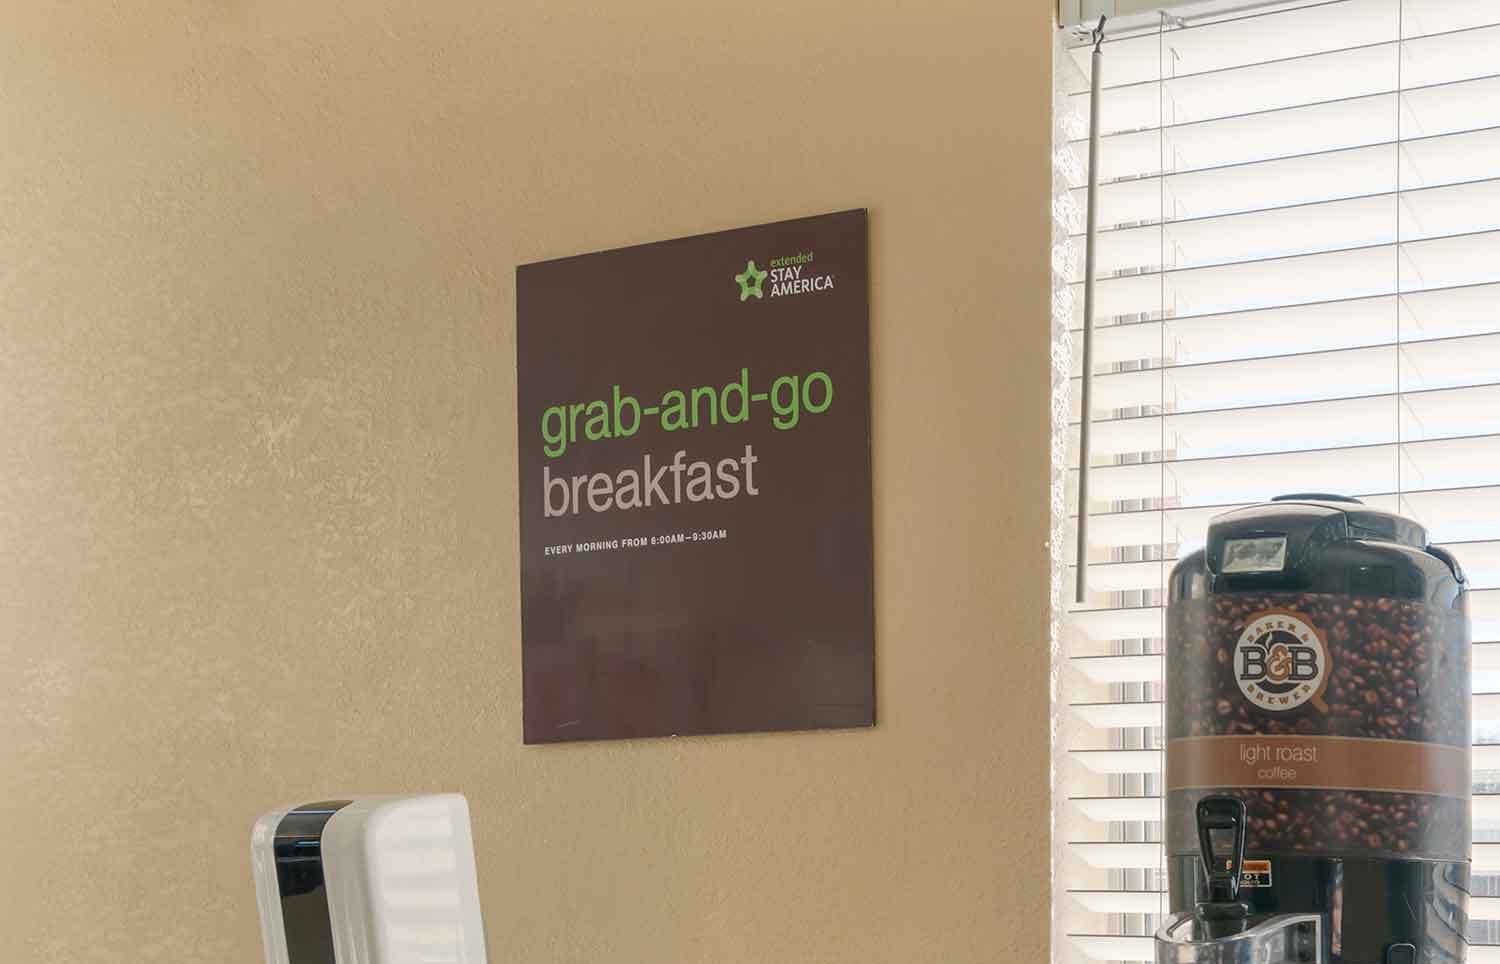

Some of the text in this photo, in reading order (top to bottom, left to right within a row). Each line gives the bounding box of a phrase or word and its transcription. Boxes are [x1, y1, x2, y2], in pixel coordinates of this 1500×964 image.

[770, 251, 813, 268] extended
[770, 265, 802, 283] STAY
[770, 275, 834, 297] AMERICA
[541, 367, 833, 458] grab-and-go
[543, 445, 759, 517] breakfast
[544, 544, 573, 555] EVERY
[576, 540, 618, 552] MORNING
[622, 537, 648, 548] FROM
[1240, 645, 1319, 681] B&B
[1240, 743, 1318, 766] light roast
[1257, 766, 1297, 781] coffee
